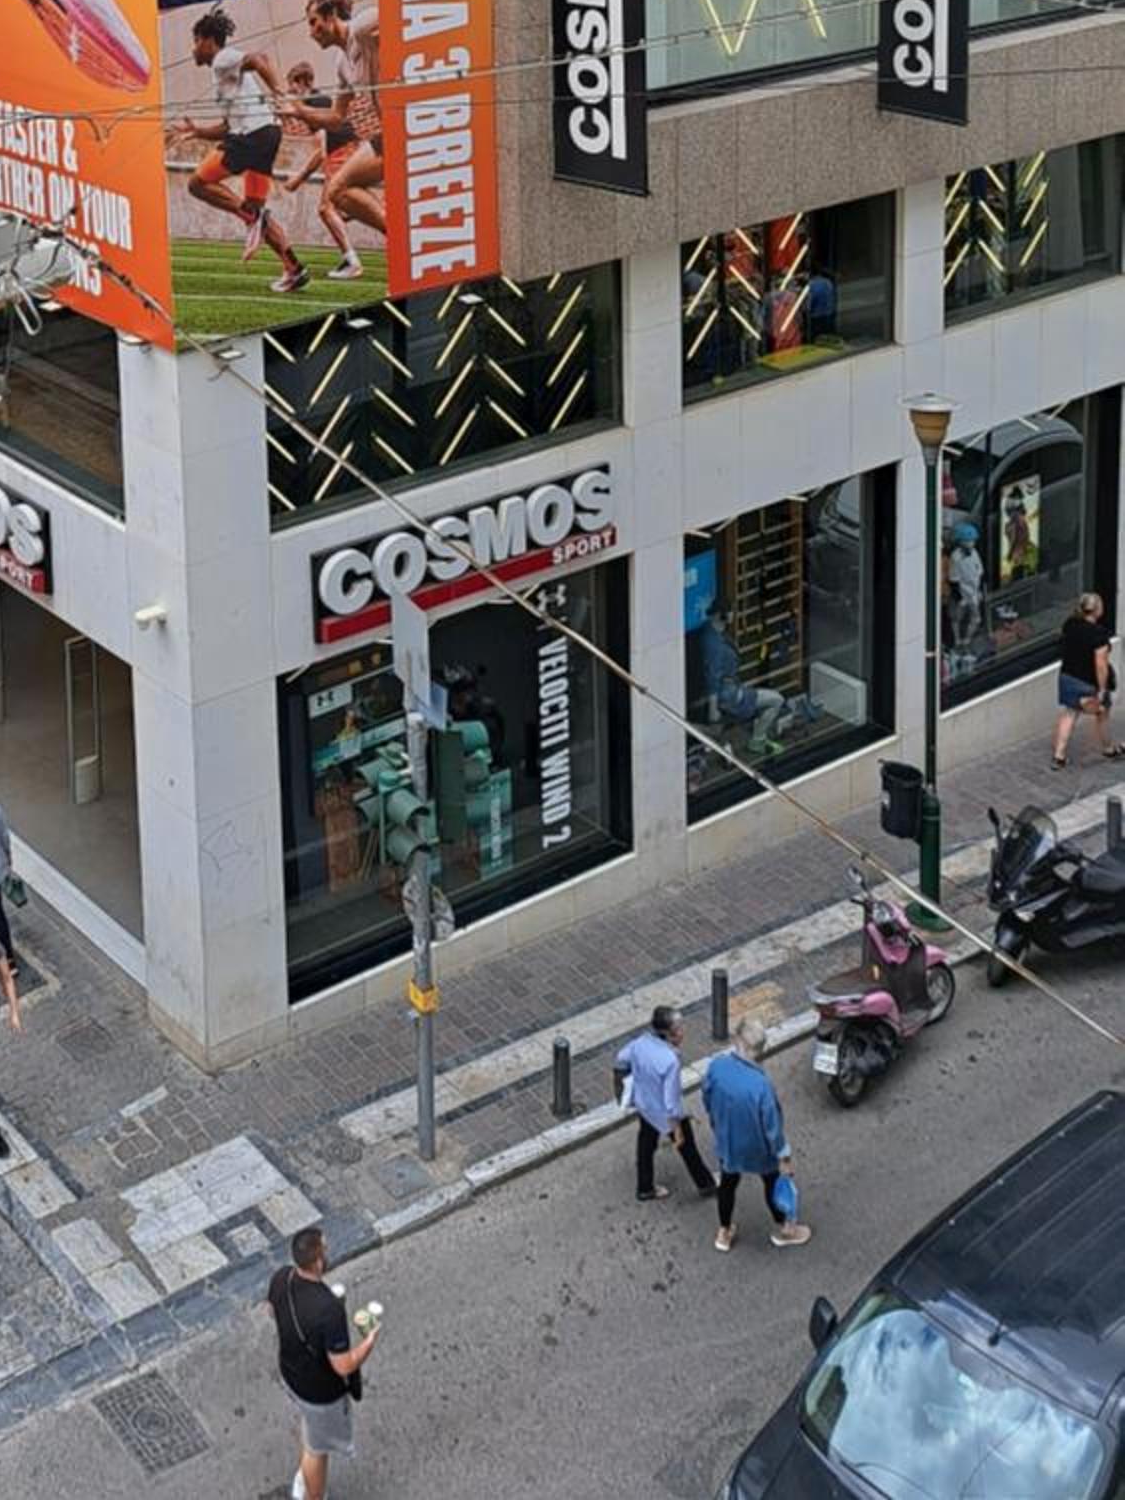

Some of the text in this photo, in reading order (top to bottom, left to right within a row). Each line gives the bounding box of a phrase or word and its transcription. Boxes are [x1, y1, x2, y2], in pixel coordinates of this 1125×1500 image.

[403, 47, 470, 84] 3
[78, 180, 133, 251] YOUR
[406, 93, 475, 280] BREEZE
[319, 470, 615, 615] COSMOS
[552, 530, 615, 565] SPORT
[538, 636, 570, 749] VELOCITI
[540, 748, 572, 825] WIND
[542, 827, 572, 850] 2
